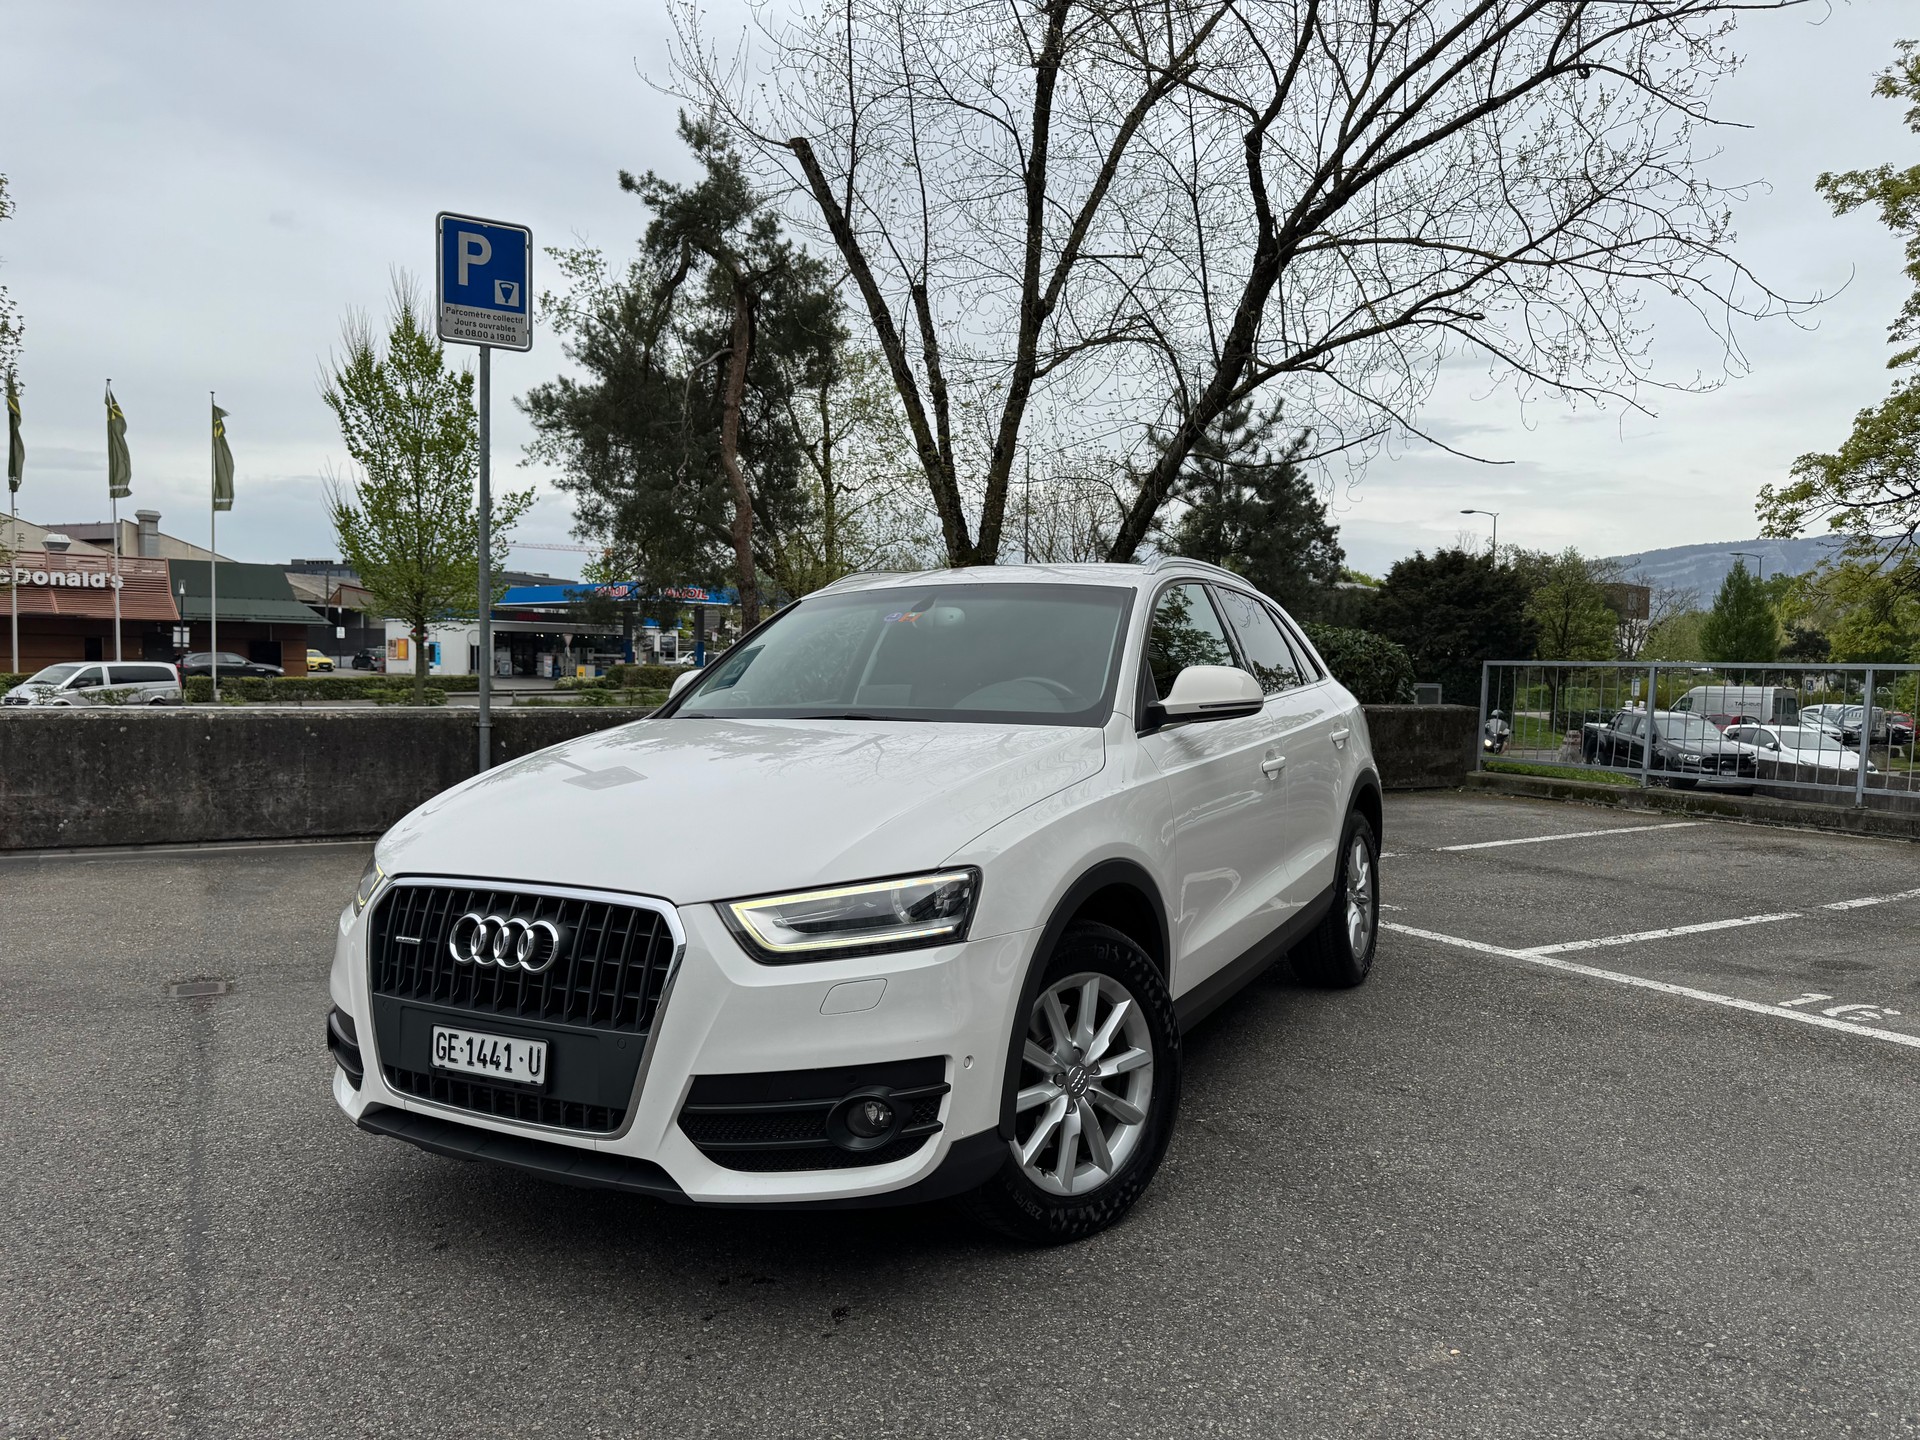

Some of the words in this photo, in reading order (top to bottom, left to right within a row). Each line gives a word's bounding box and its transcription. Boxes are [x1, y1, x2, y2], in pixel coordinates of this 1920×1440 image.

[458, 231, 492, 286] P
[446, 306, 491, 320] Parcomètre
[493, 314, 524, 324] collectif
[454, 318, 477, 328] Jours
[479, 322, 516, 333] ouvrables
[454, 328, 464, 336] de
